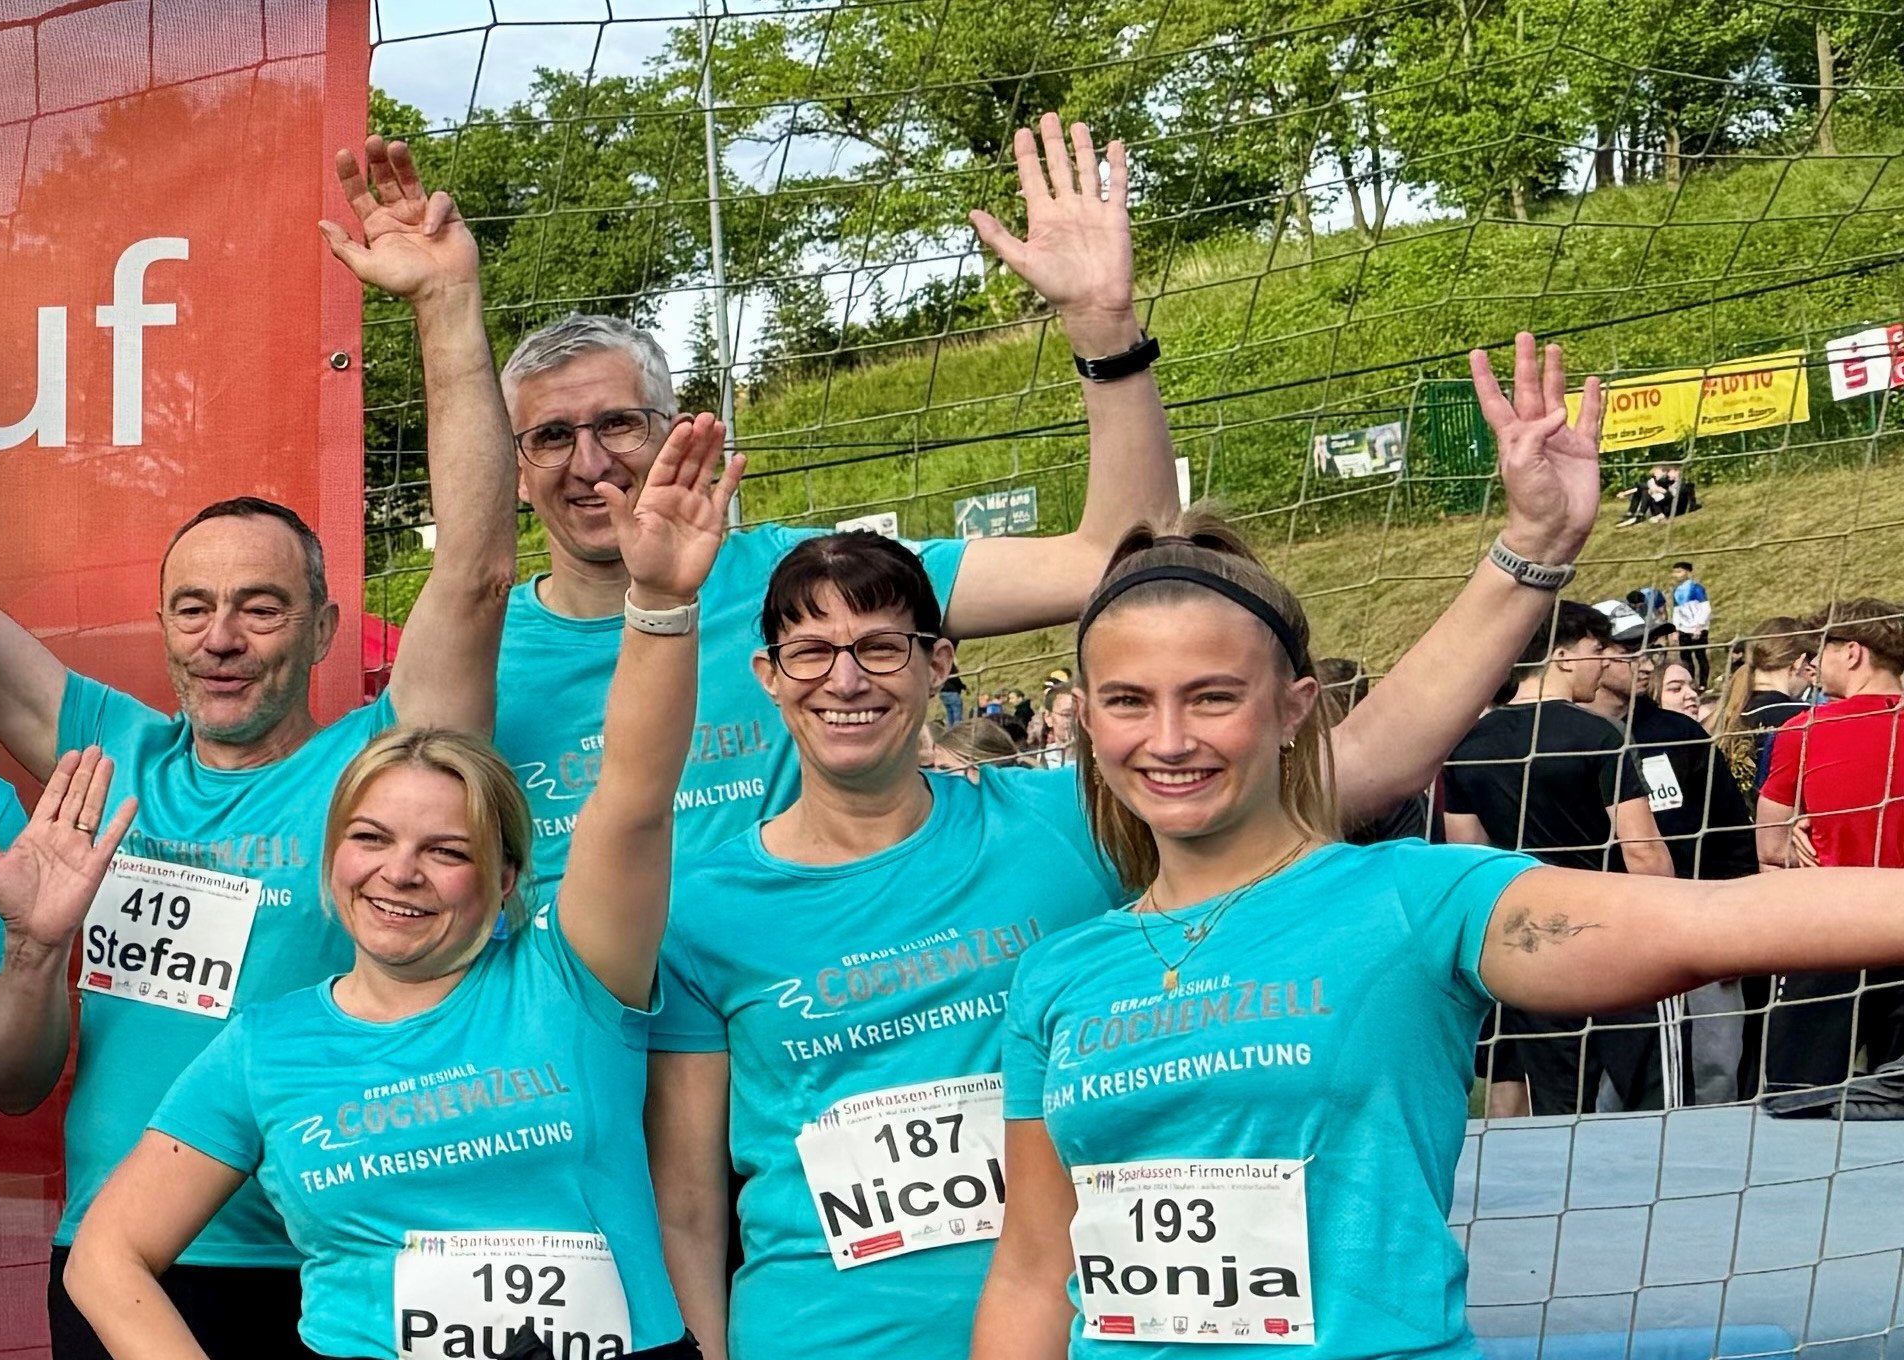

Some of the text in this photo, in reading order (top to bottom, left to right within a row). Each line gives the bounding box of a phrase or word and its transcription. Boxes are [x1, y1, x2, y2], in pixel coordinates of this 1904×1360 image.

[120, 887, 191, 930] 419
[87, 924, 234, 991] Stefan
[817, 918, 1044, 1009] COCHEMZELL
[783, 991, 1009, 1063] TEAM KREISVERWALT
[1077, 977, 1333, 1057] COCHEMZELL
[336, 1061, 571, 1138] COCHEMZELL
[843, 1077, 1004, 1117] Sparkassen-Firmenlau
[1081, 1043, 1312, 1102] KREISVERWALTUNG
[299, 1120, 574, 1193] TEAM KREISVERWALTUNG
[874, 1114, 964, 1163] 187
[819, 1157, 1005, 1238] Nicol
[1118, 1164, 1279, 1184] Sparkassen-Firmenlauf
[1128, 1197, 1217, 1244] 193
[472, 1263, 567, 1308] 192
[1079, 1254, 1301, 1308] Ronja
